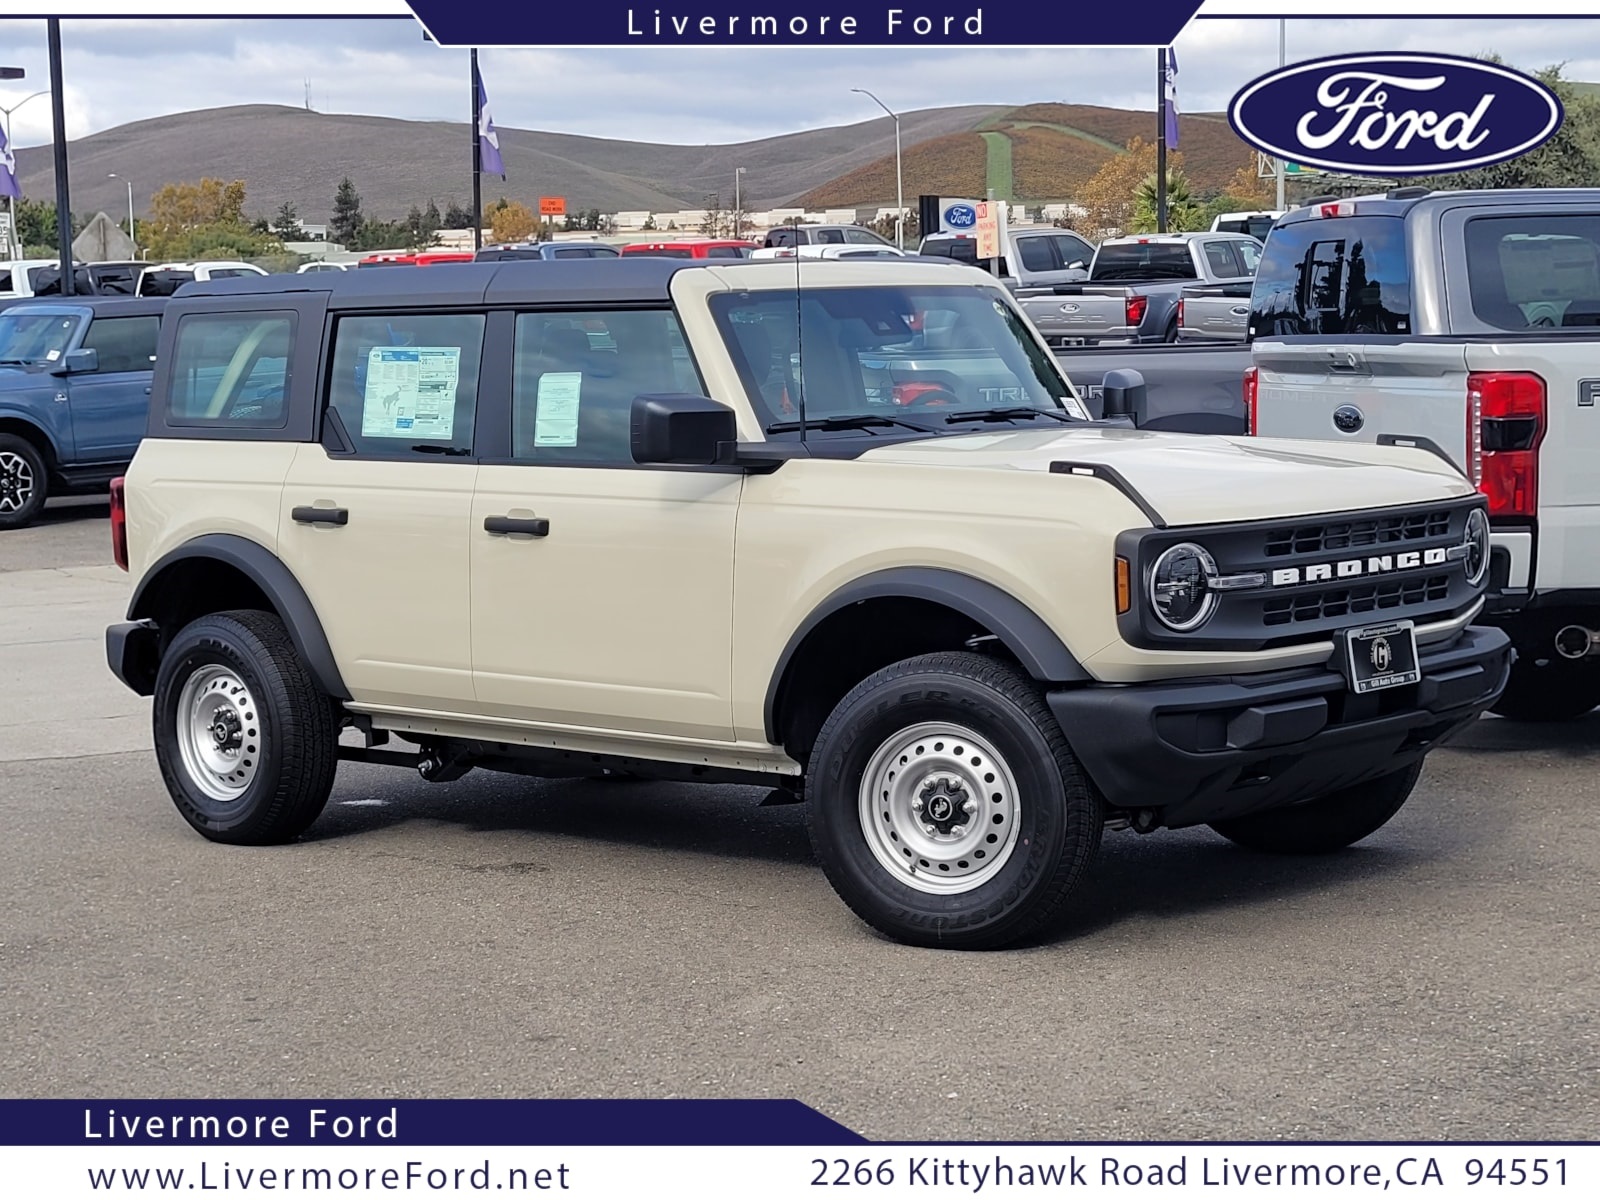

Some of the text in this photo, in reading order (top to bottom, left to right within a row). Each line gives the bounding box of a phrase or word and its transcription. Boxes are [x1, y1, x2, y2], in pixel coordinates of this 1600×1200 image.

[950, 207, 973, 225] Ford
[977, 205, 987, 217] NO
[1272, 548, 1447, 586] BRONCO
